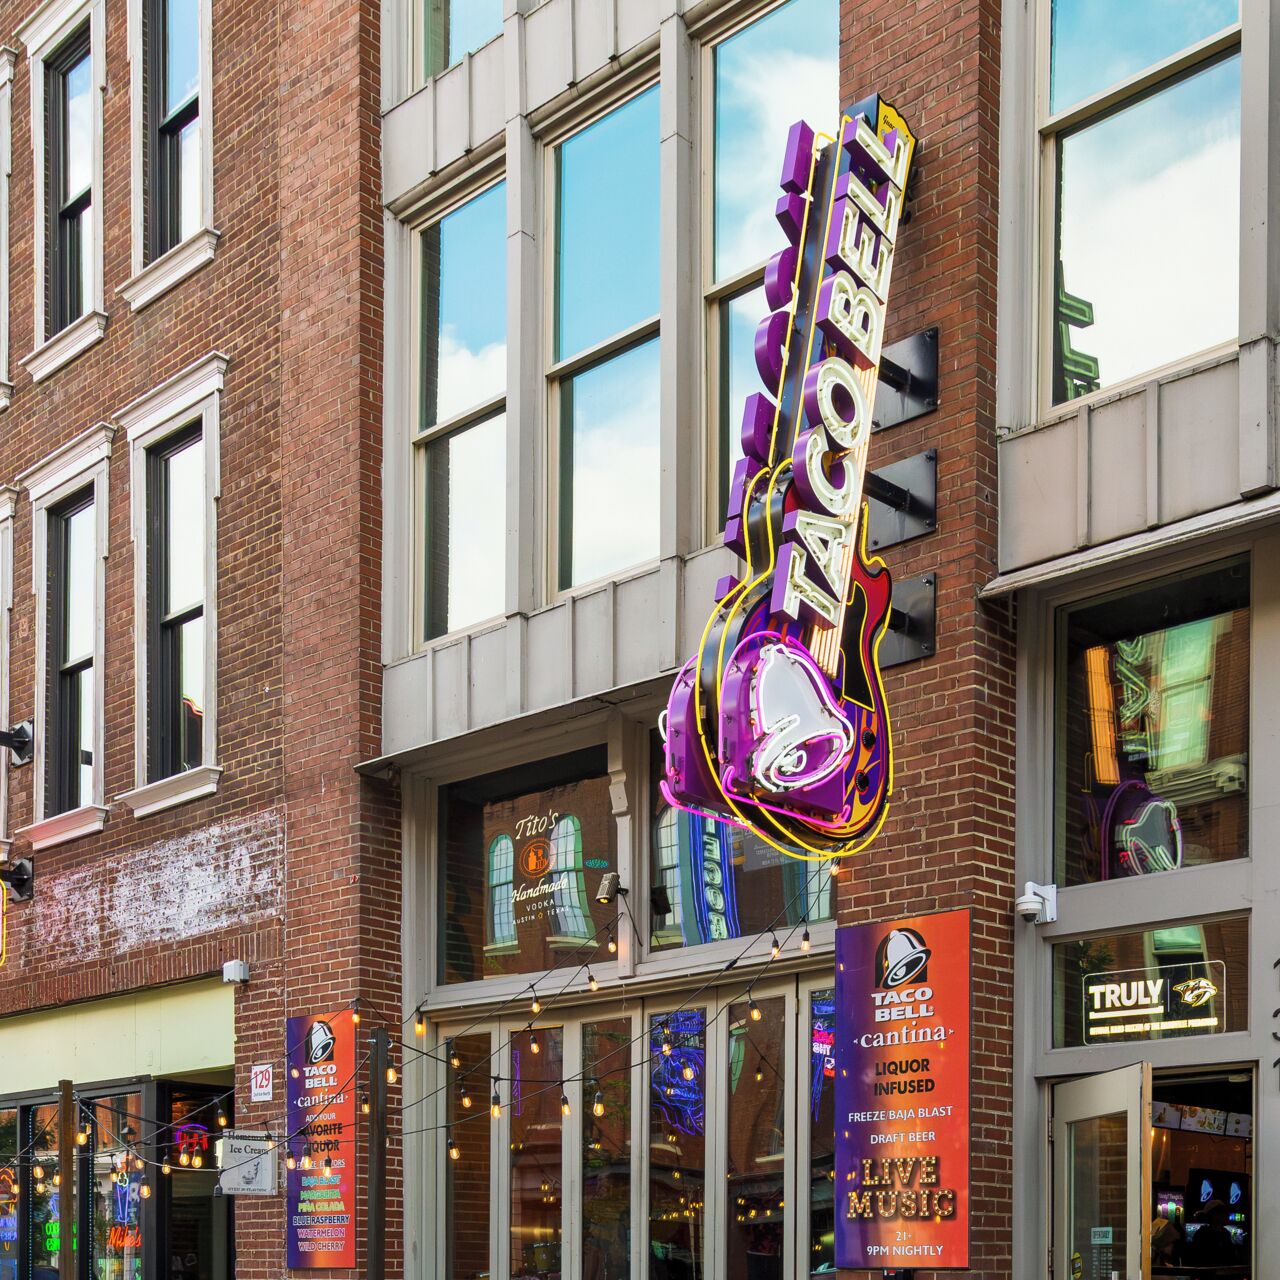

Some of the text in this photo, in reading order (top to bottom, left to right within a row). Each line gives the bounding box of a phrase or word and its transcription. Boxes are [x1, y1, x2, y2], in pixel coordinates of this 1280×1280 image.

[780, 112, 910, 624] TACO BELL
[515, 809, 559, 839] Tito's
[511, 872, 568, 903] Handmade
[526, 899, 555, 911] VODKA
[513, 915, 535, 925] AUSTIN
[871, 987, 934, 1006] TACO
[1088, 978, 1164, 1009] TRULY
[875, 1003, 934, 1022] BELL
[860, 1021, 947, 1048] cantina
[303, 1064, 336, 1077] TACO
[875, 1058, 930, 1076] LIQUOR
[253, 1069, 271, 1089] 129
[305, 1076, 337, 1089] BELL
[874, 1079, 935, 1096] INFUSED
[297, 1089, 345, 1108] cantina
[320, 1112, 336, 1120] YOUR
[848, 1106, 953, 1122] FREEZE BAJA BLAST
[301, 1123, 342, 1138] AVORITE
[870, 1131, 936, 1144] DRAFT BEER
[230, 1144, 242, 1154] Ice
[307, 1140, 339, 1153] IQUOR
[862, 1156, 938, 1185] LIVE
[847, 1188, 954, 1219] MUSIC
[293, 1214, 350, 1225] BLUE RASPBERRY
[297, 1227, 345, 1239] WATERMELON
[895, 1231, 912, 1241] 21+
[297, 1241, 345, 1252] WILD CHERRY
[867, 1244, 944, 1256] 9PM NIGHTLY
